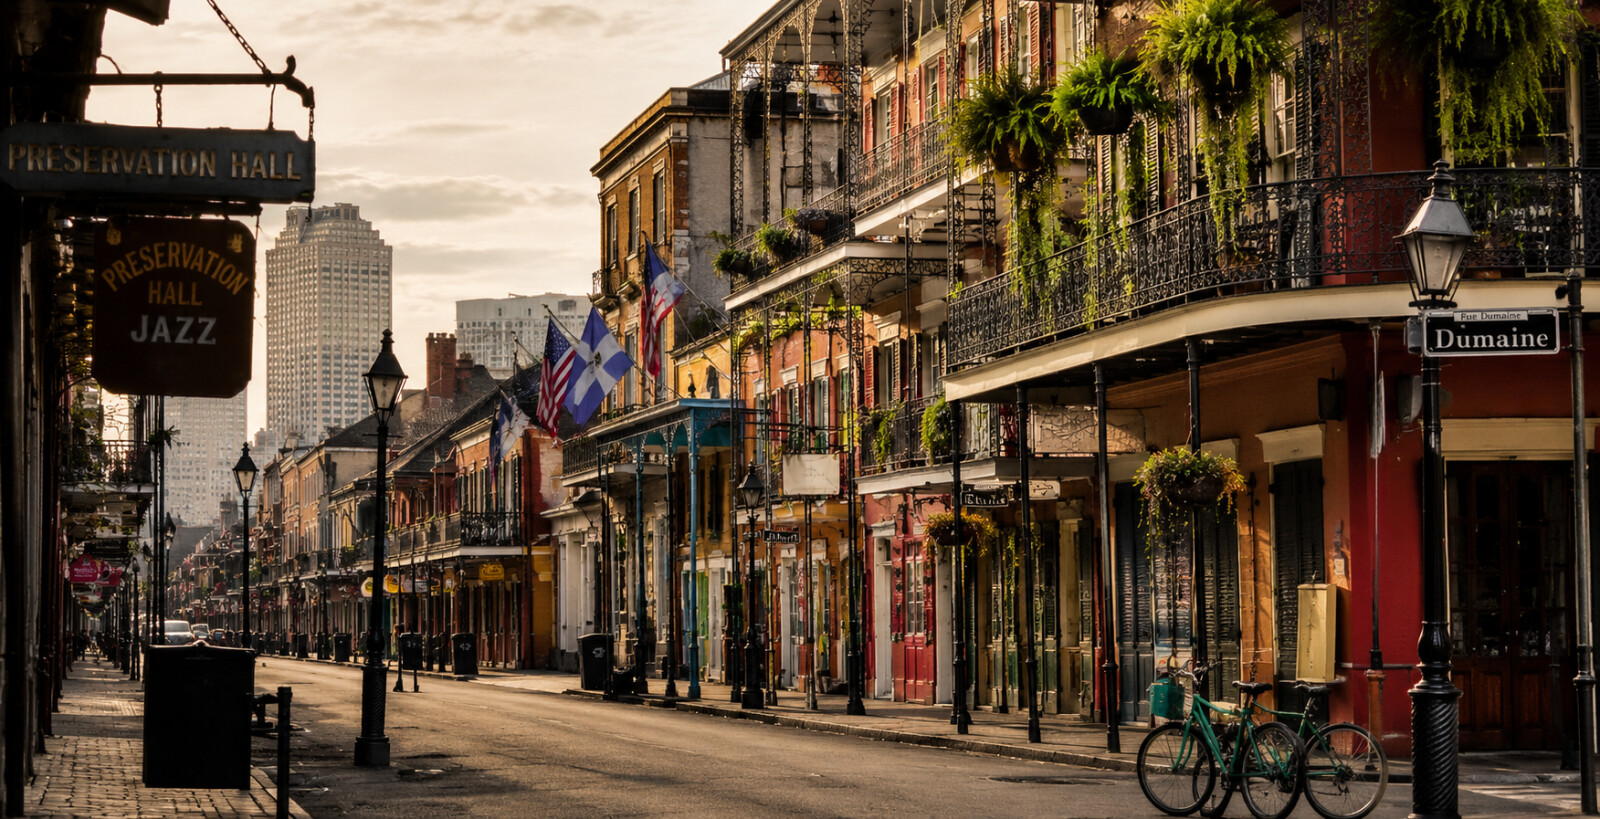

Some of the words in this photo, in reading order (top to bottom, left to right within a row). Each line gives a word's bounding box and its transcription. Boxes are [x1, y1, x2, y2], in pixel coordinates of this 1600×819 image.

[8, 143, 216, 178] PRESERVATION
[231, 151, 302, 180] HALL
[101, 241, 249, 295] PRESERVATION
[148, 280, 203, 306] HALL
[130, 314, 217, 345] JAZZ
[1481, 311, 1521, 320] Dumaine
[1435, 327, 1548, 349] Dumaine
